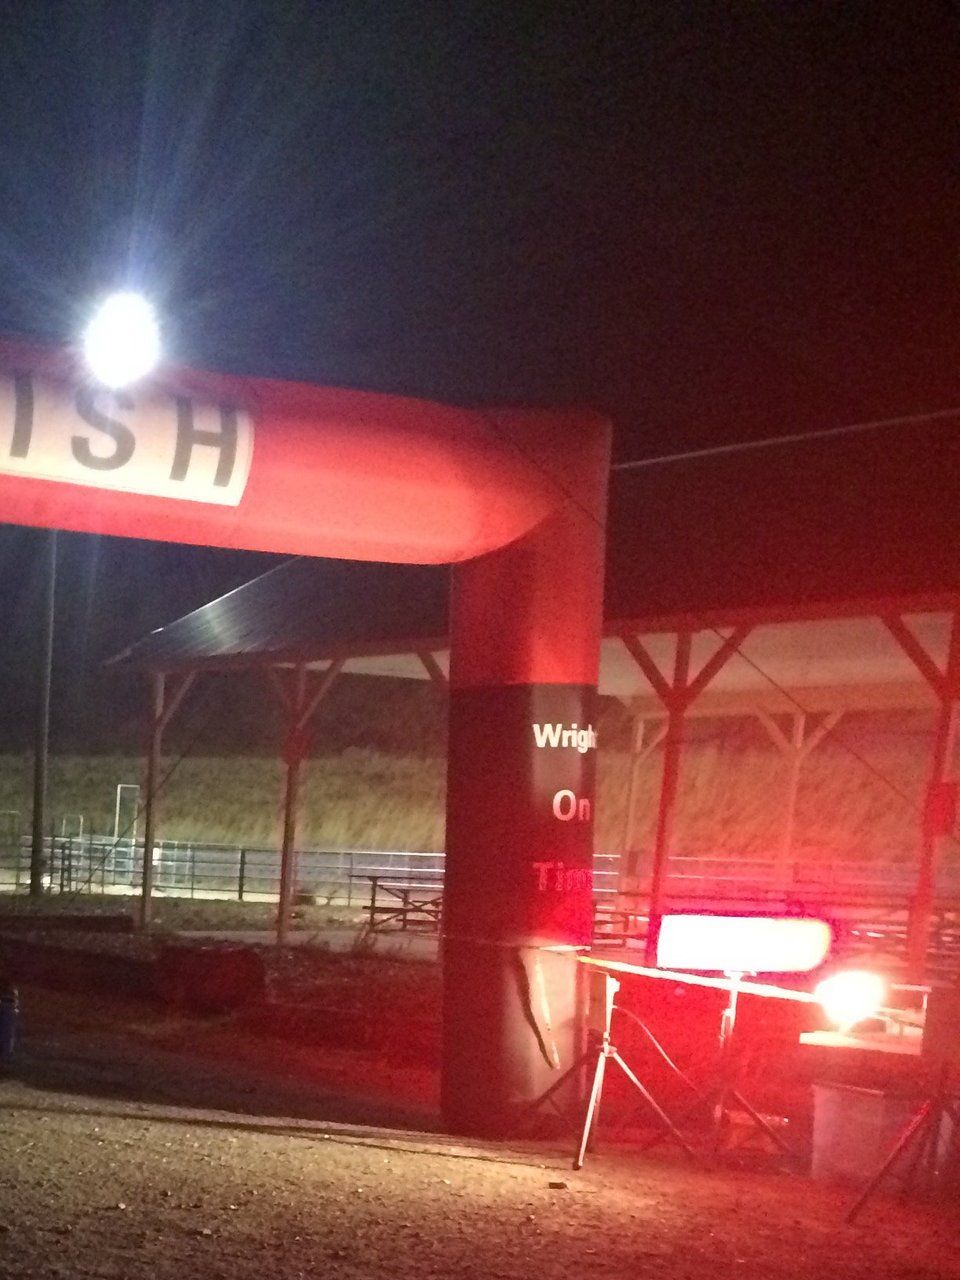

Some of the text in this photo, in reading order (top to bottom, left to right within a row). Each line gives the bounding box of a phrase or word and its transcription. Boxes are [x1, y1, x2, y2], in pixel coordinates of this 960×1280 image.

[533, 723, 597, 753] Wrigh
[552, 789, 590, 821] On
[532, 861, 593, 891] Tim
